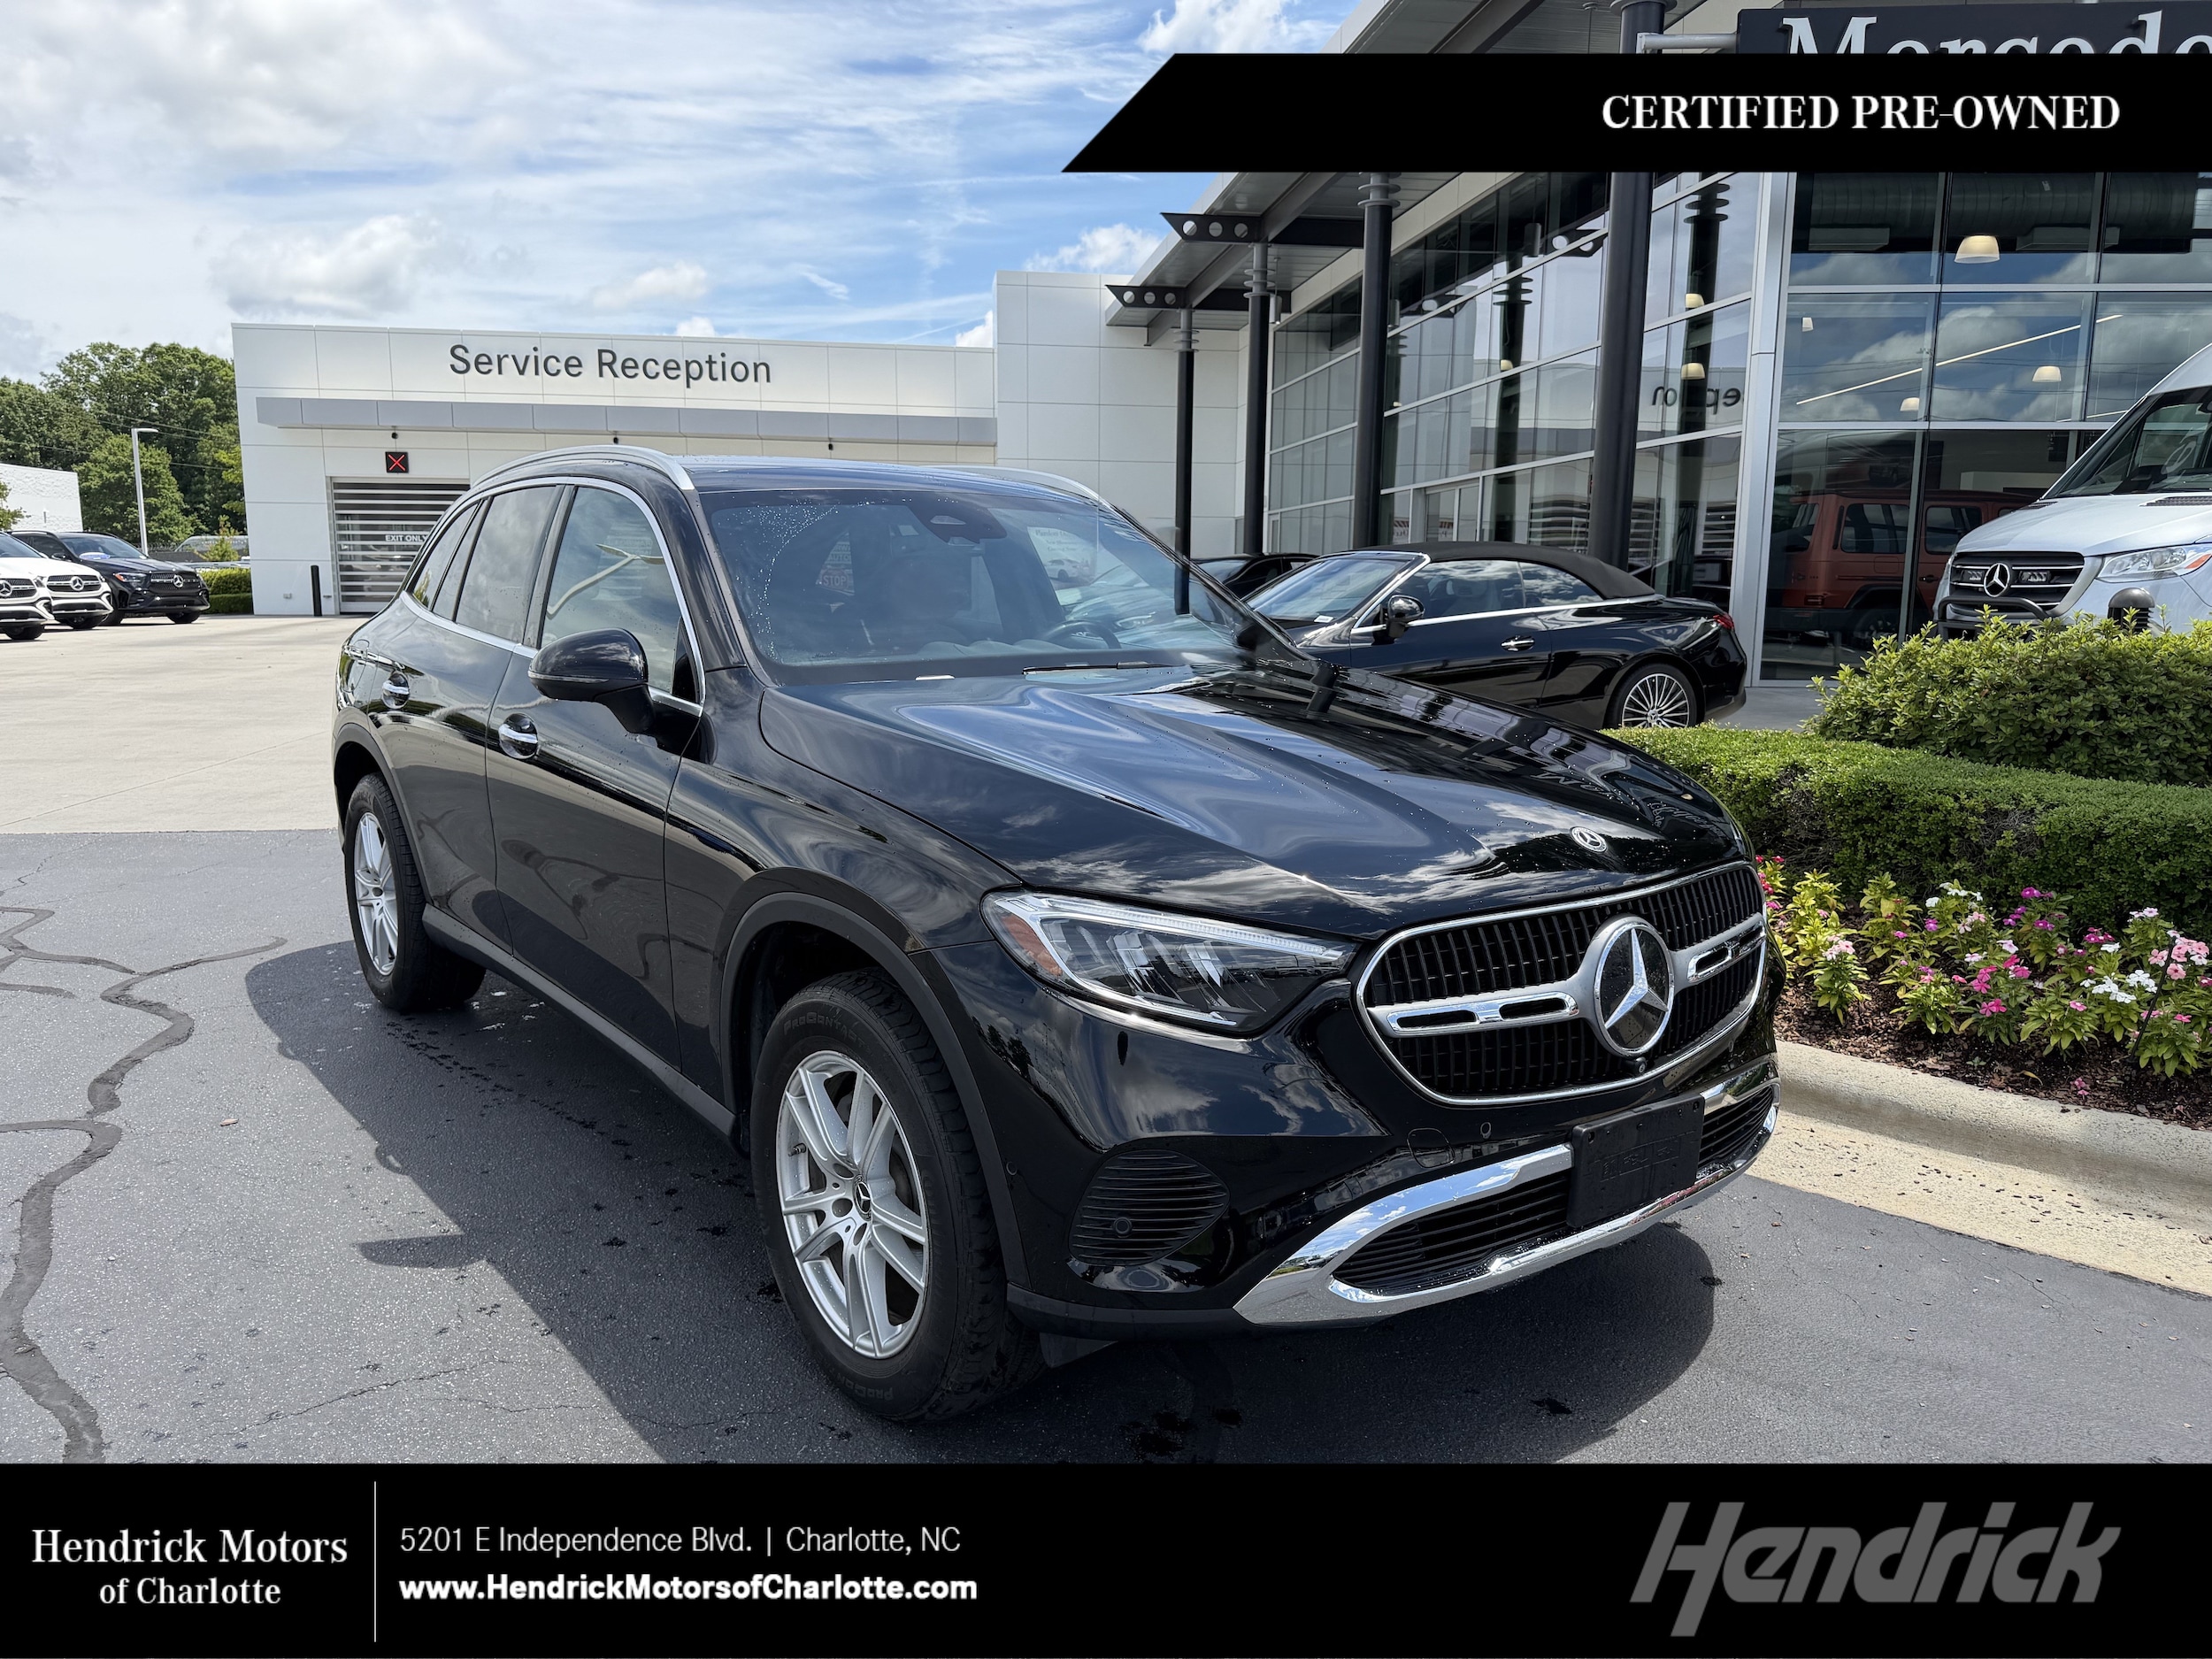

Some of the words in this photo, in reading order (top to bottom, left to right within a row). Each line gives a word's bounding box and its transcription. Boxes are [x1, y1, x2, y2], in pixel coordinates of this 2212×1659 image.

[449, 344, 583, 378] Service
[597, 349, 772, 388] Reception
[823, 575, 847, 587] STOP
